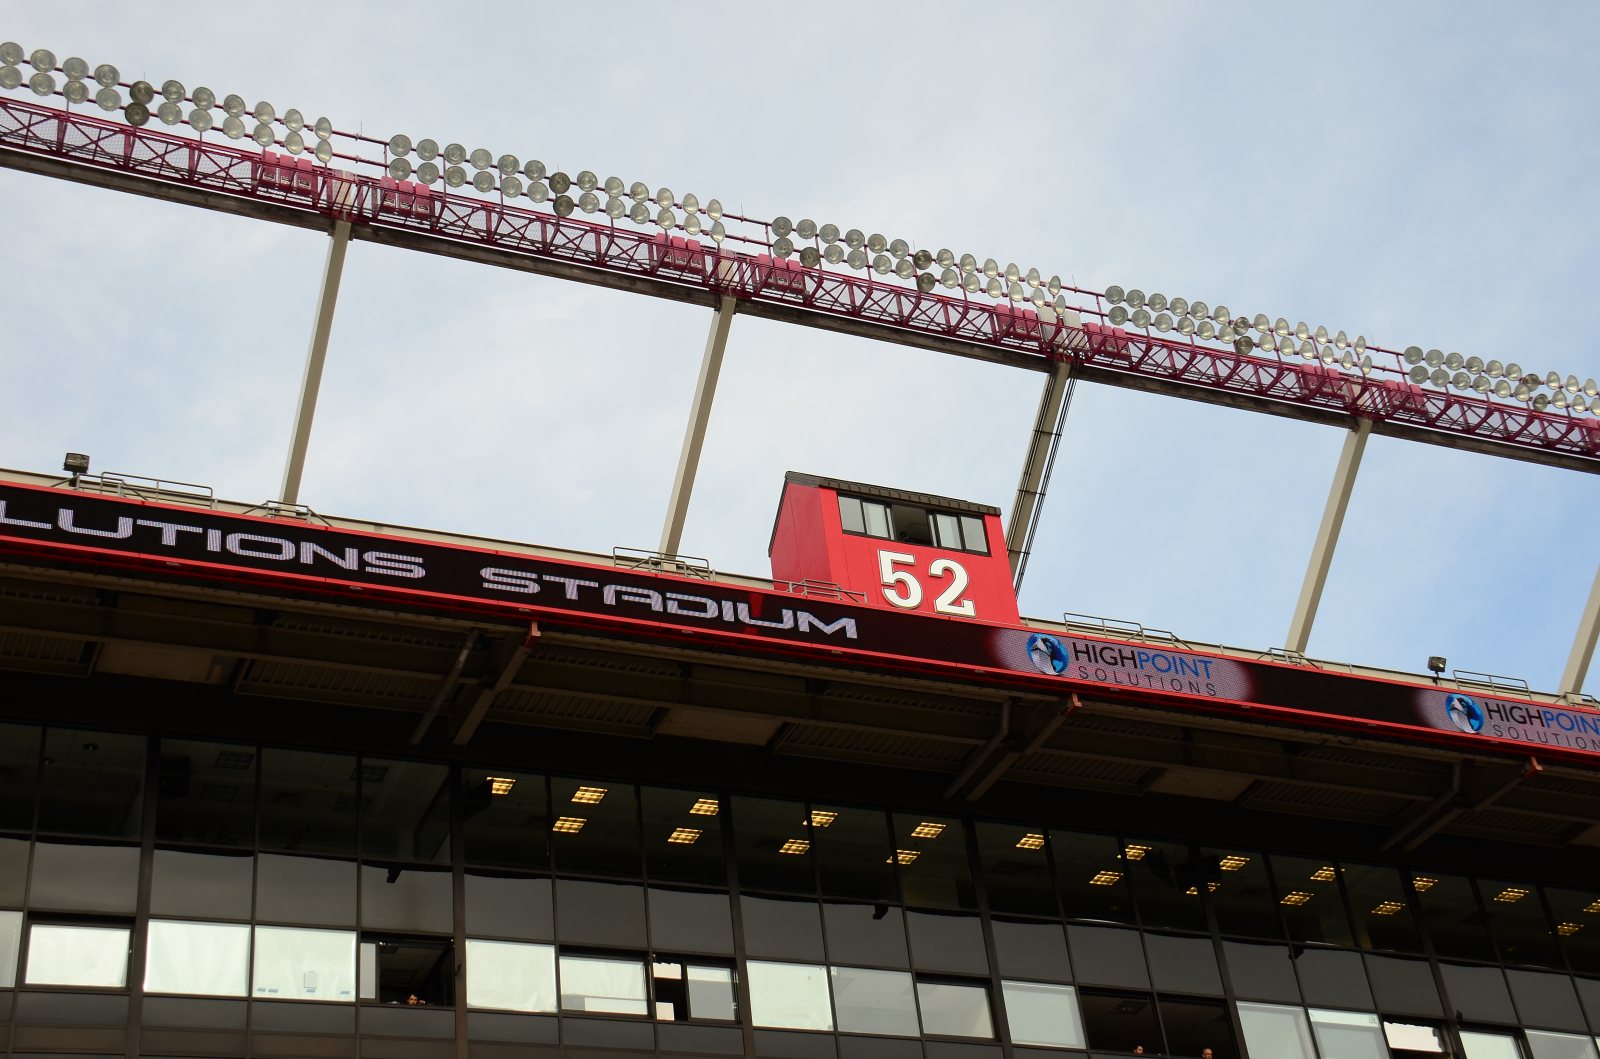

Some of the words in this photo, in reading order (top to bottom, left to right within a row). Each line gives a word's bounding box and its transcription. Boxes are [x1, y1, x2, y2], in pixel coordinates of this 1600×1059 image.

[0, 500, 426, 579] LUTIONS
[479, 566, 858, 639] STADIUM
[877, 548, 976, 618] 52
[1072, 641, 1213, 679] HIGHPOINT
[1078, 665, 1216, 696] SOLUTIONS
[1485, 702, 1600, 736] HIGHPOIN
